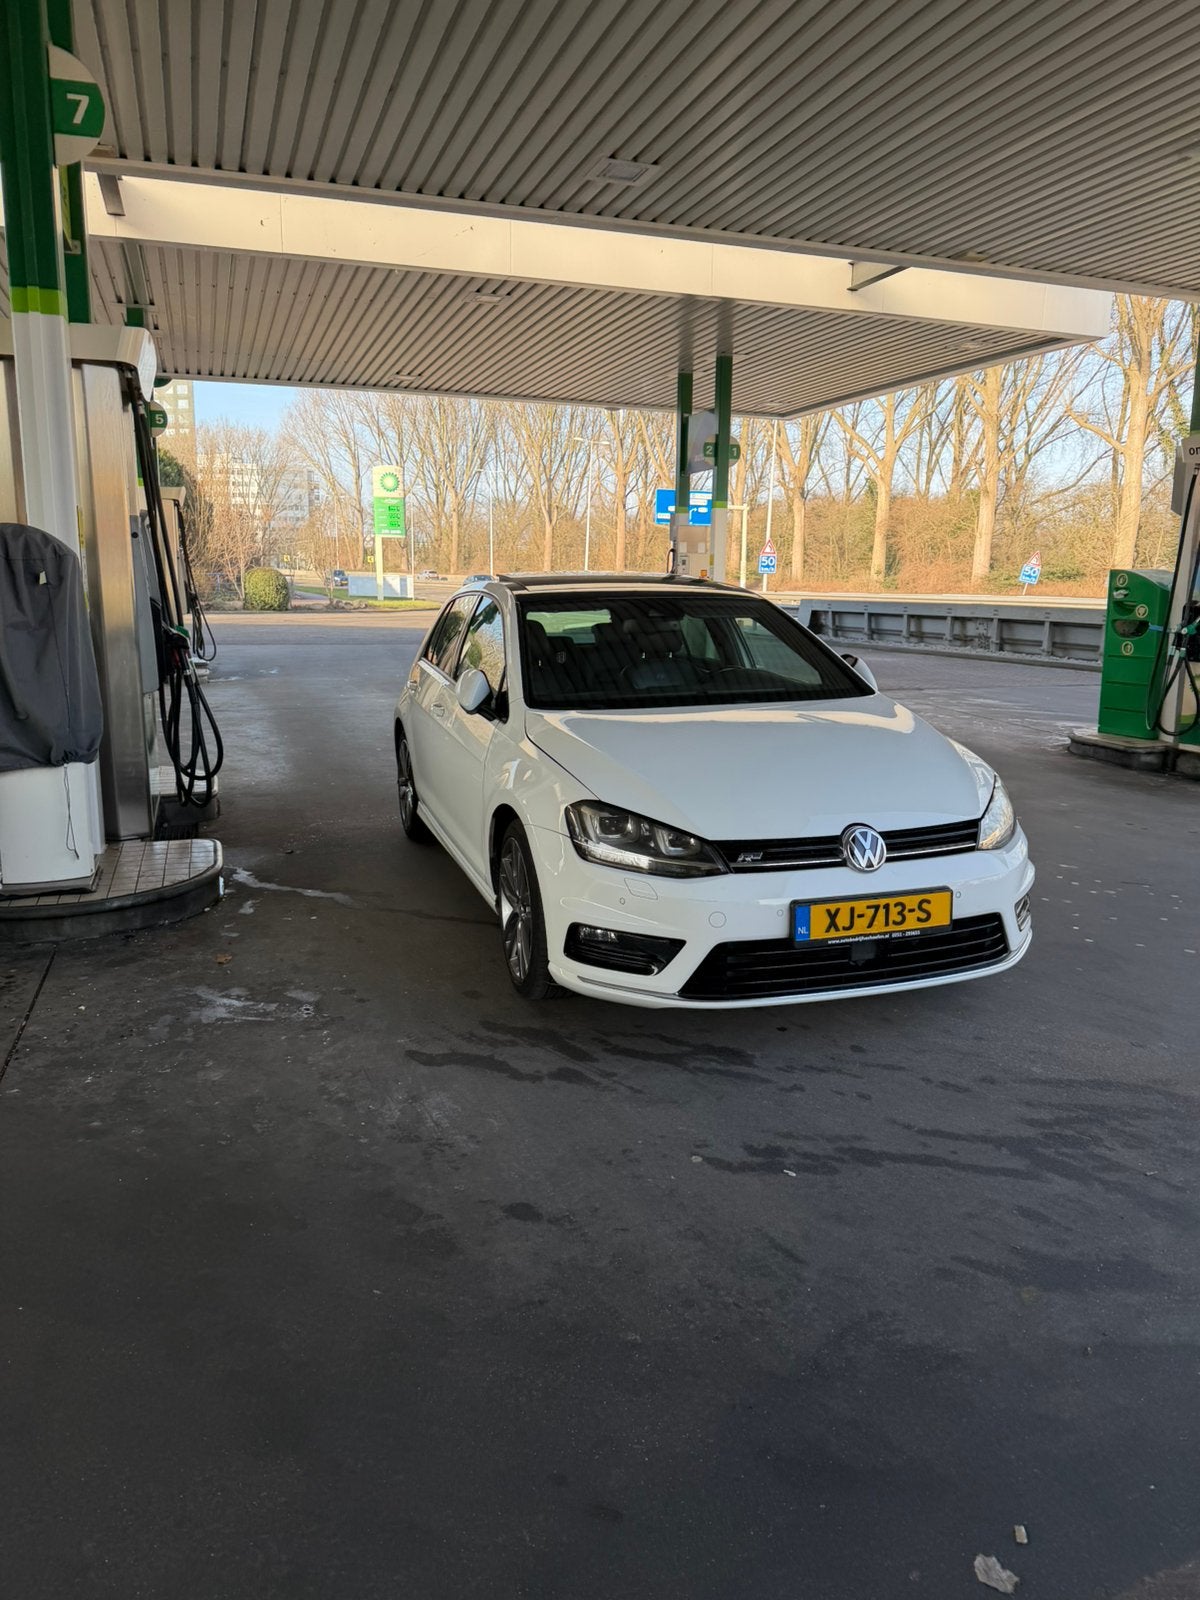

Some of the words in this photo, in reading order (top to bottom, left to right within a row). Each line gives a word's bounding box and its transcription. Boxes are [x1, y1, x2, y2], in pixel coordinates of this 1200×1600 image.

[66, 92, 90, 125] 7
[155, 413, 164, 424] 5
[705, 445, 713, 455] 2
[731, 447, 737, 457] 1
[761, 556, 775, 566] 50
[1023, 566, 1039, 577] 50
[824, 898, 932, 933] XJ-713-S
[797, 927, 809, 935] NL
